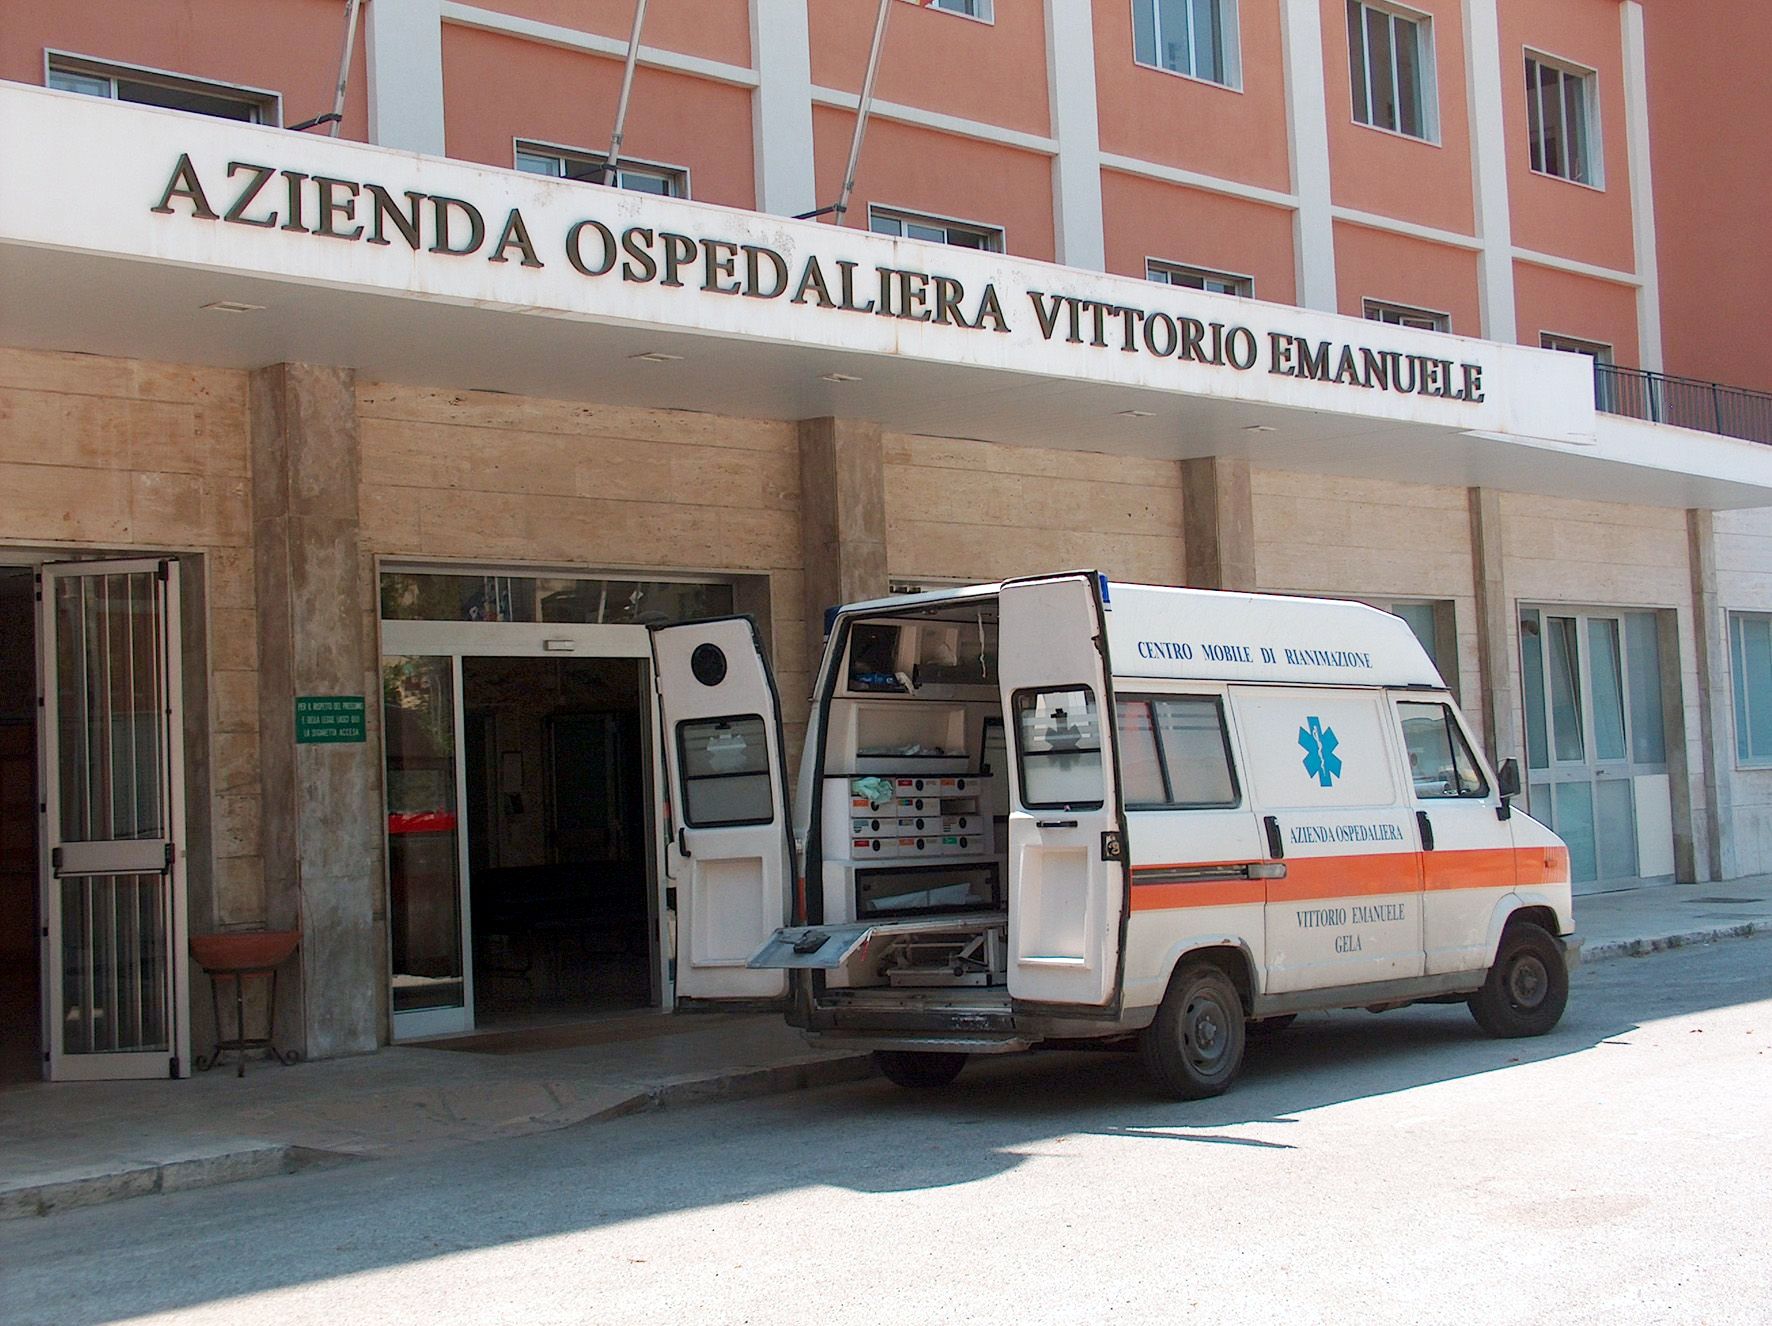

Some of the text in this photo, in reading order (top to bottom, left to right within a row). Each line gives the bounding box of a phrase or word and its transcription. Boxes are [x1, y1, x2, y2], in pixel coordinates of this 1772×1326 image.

[151, 153, 1485, 403] AZIENDA OSPEDALIERA VITTORIO EMANUELE
[1137, 641, 1373, 669] CENTRO MOBILE DI RIANIMAZIONE
[339, 727, 359, 736] ACCESA
[1290, 823, 1404, 843] AZIENDA OSPEDALIERA
[1297, 904, 1405, 928] VITTORIO EMANUELE
[1335, 935, 1362, 953] GELA
